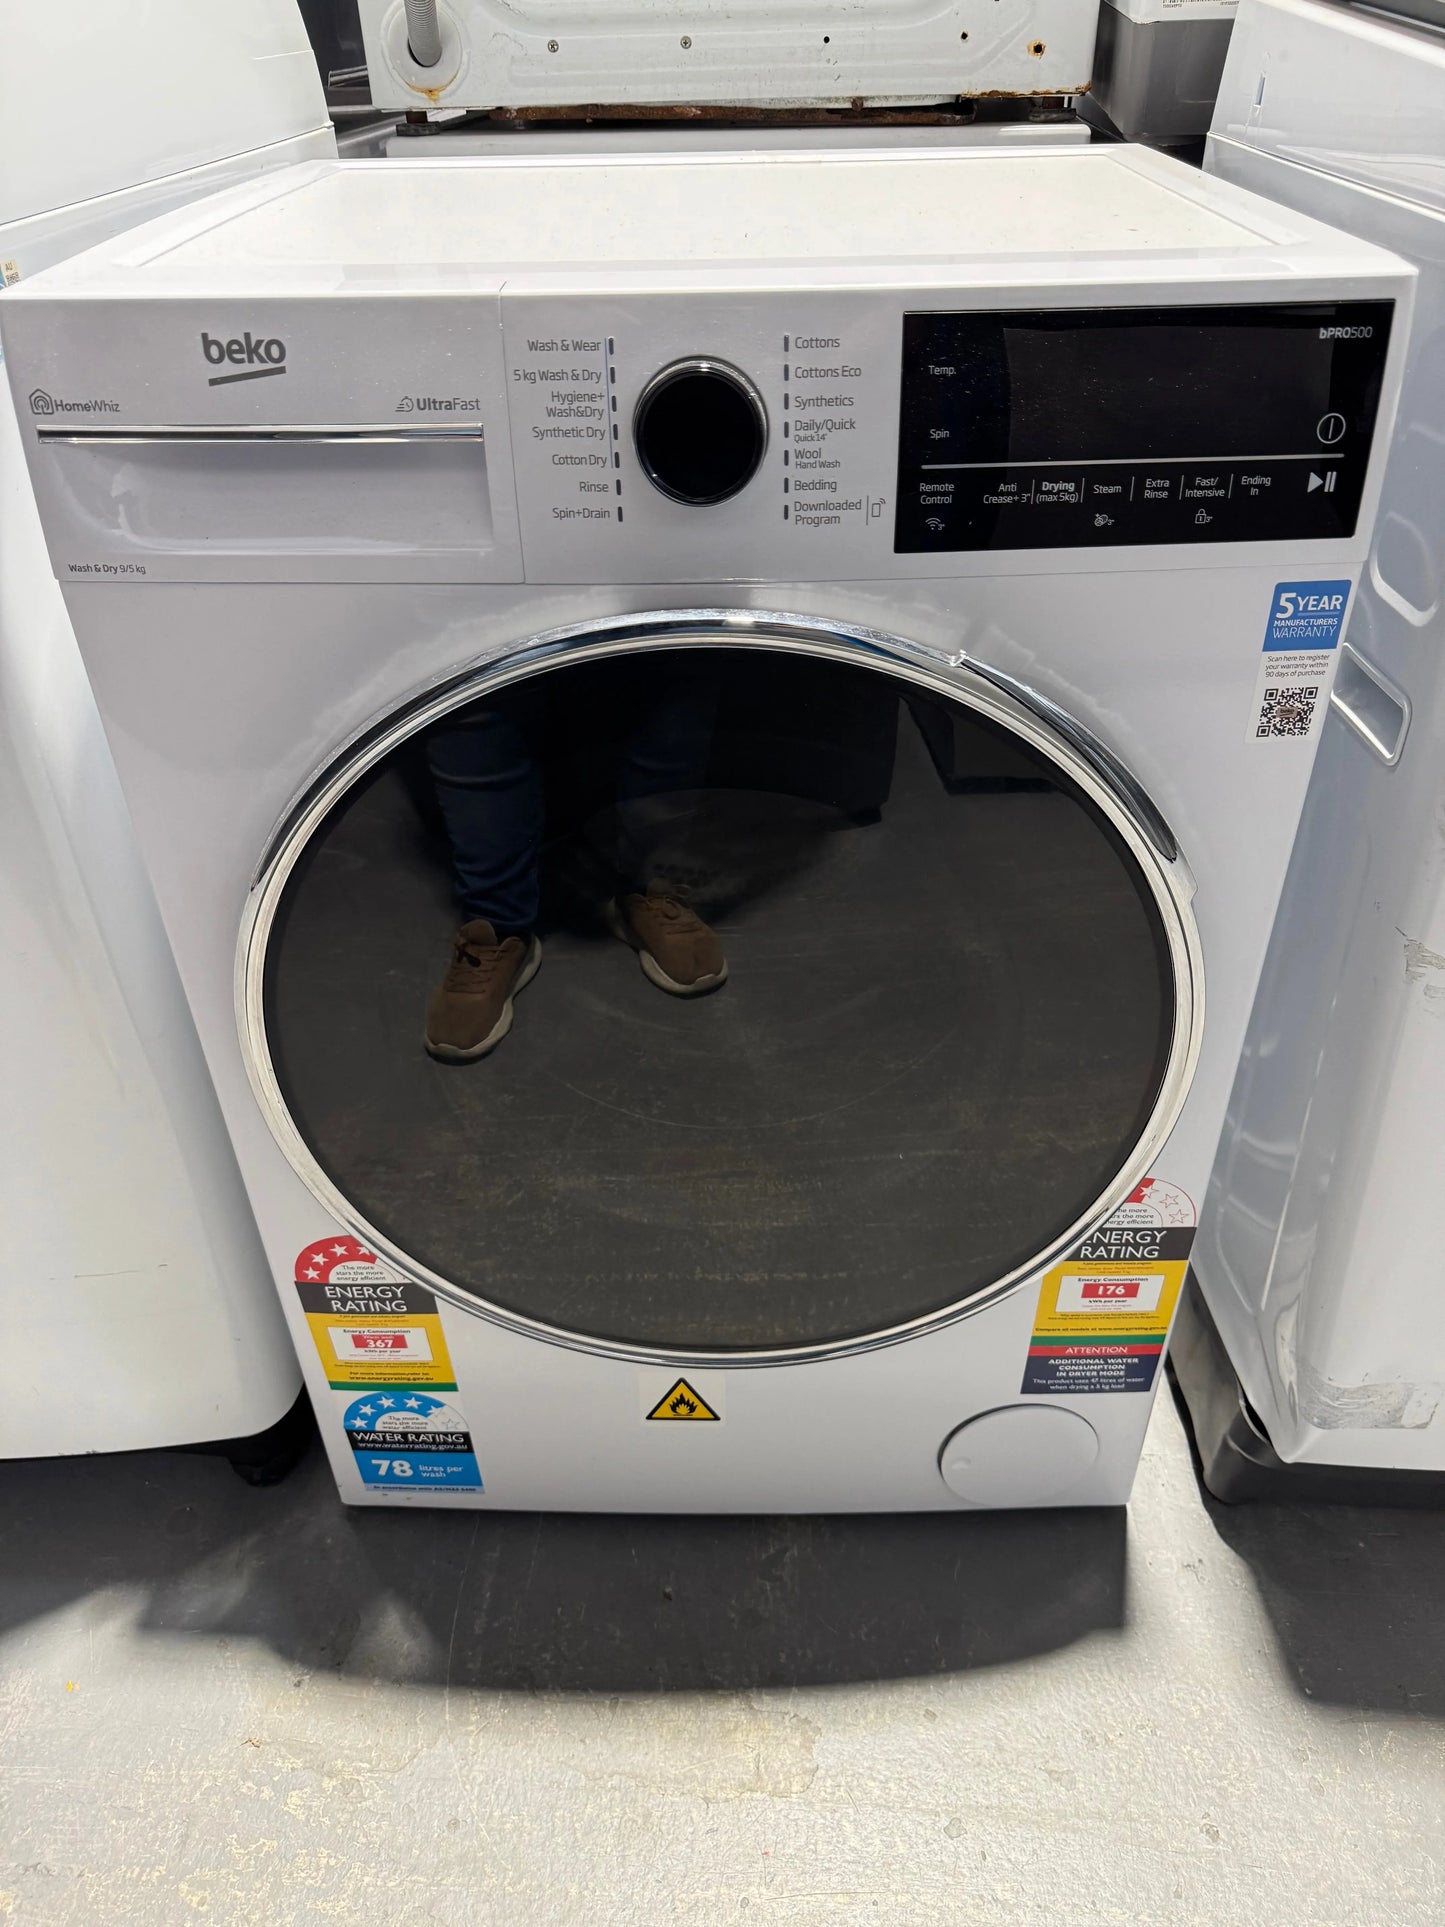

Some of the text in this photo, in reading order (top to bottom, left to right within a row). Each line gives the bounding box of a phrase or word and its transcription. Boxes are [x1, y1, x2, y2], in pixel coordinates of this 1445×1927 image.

[1319, 326, 1373, 339] bPRO500
[201, 332, 287, 365] beko
[527, 339, 602, 352] Wash & Wear
[795, 336, 841, 349] Cottons
[513, 368, 602, 384] 5 kg Wash & Dry
[795, 365, 862, 379] Cottons Eco
[928, 365, 957, 377] Temp.
[416, 397, 481, 411] UltraFast
[551, 390, 605, 406] Hygiene+
[794, 394, 854, 411] Synthetics
[54, 399, 120, 413] HomeWhiz
[546, 406, 605, 421] Wash&Dry
[794, 418, 857, 433] Daily/Quick
[532, 426, 606, 441] Synthetic Dry
[794, 432, 815, 444] Quick
[930, 428, 950, 441] Spin
[794, 448, 822, 460] Wool
[552, 454, 608, 468] Cotton Dry
[795, 459, 841, 470] Hand Wash
[579, 481, 609, 493] Rinse
[794, 479, 837, 493] Bedding
[1041, 481, 1076, 493] Drying
[1145, 478, 1170, 488] Extra
[1195, 476, 1219, 487] Fast/
[1241, 475, 1271, 487] Ending
[919, 482, 955, 493] Remote
[998, 482, 1018, 493] Anti
[1093, 484, 1122, 495] Steam
[1185, 488, 1226, 498] Intensive
[1250, 488, 1260, 496] In
[920, 494, 953, 505] Control
[1036, 492, 1059, 504] (max
[1144, 489, 1169, 499] Rinse
[794, 499, 862, 512] Downloaded
[552, 507, 611, 520] Spin+Drain
[795, 514, 841, 528] Program
[68, 564, 146, 575] Wash & Dry 9/5 kg
[1275, 592, 1344, 619] 5 YEAR
[1273, 617, 1339, 628] MANUFACTURERS
[1272, 625, 1337, 639] WARRANTY
[1305, 654, 1330, 662] register
[1280, 662, 1308, 670] warranty
[1274, 670, 1290, 678] days
[1297, 669, 1326, 677] purchase
[1080, 1245, 1160, 1259] RATING
[324, 1286, 404, 1298] ENERGY
[1097, 1285, 1125, 1296] 176
[331, 1300, 408, 1312] RATING
[366, 1339, 394, 1348] 367
[1065, 1346, 1129, 1354] ATTENTION
[1099, 1369, 1126, 1377] MODE
[353, 1432, 465, 1443] WATER RATING
[358, 1442, 468, 1450] www.waterrating.gov.au
[371, 1459, 413, 1477] 78
